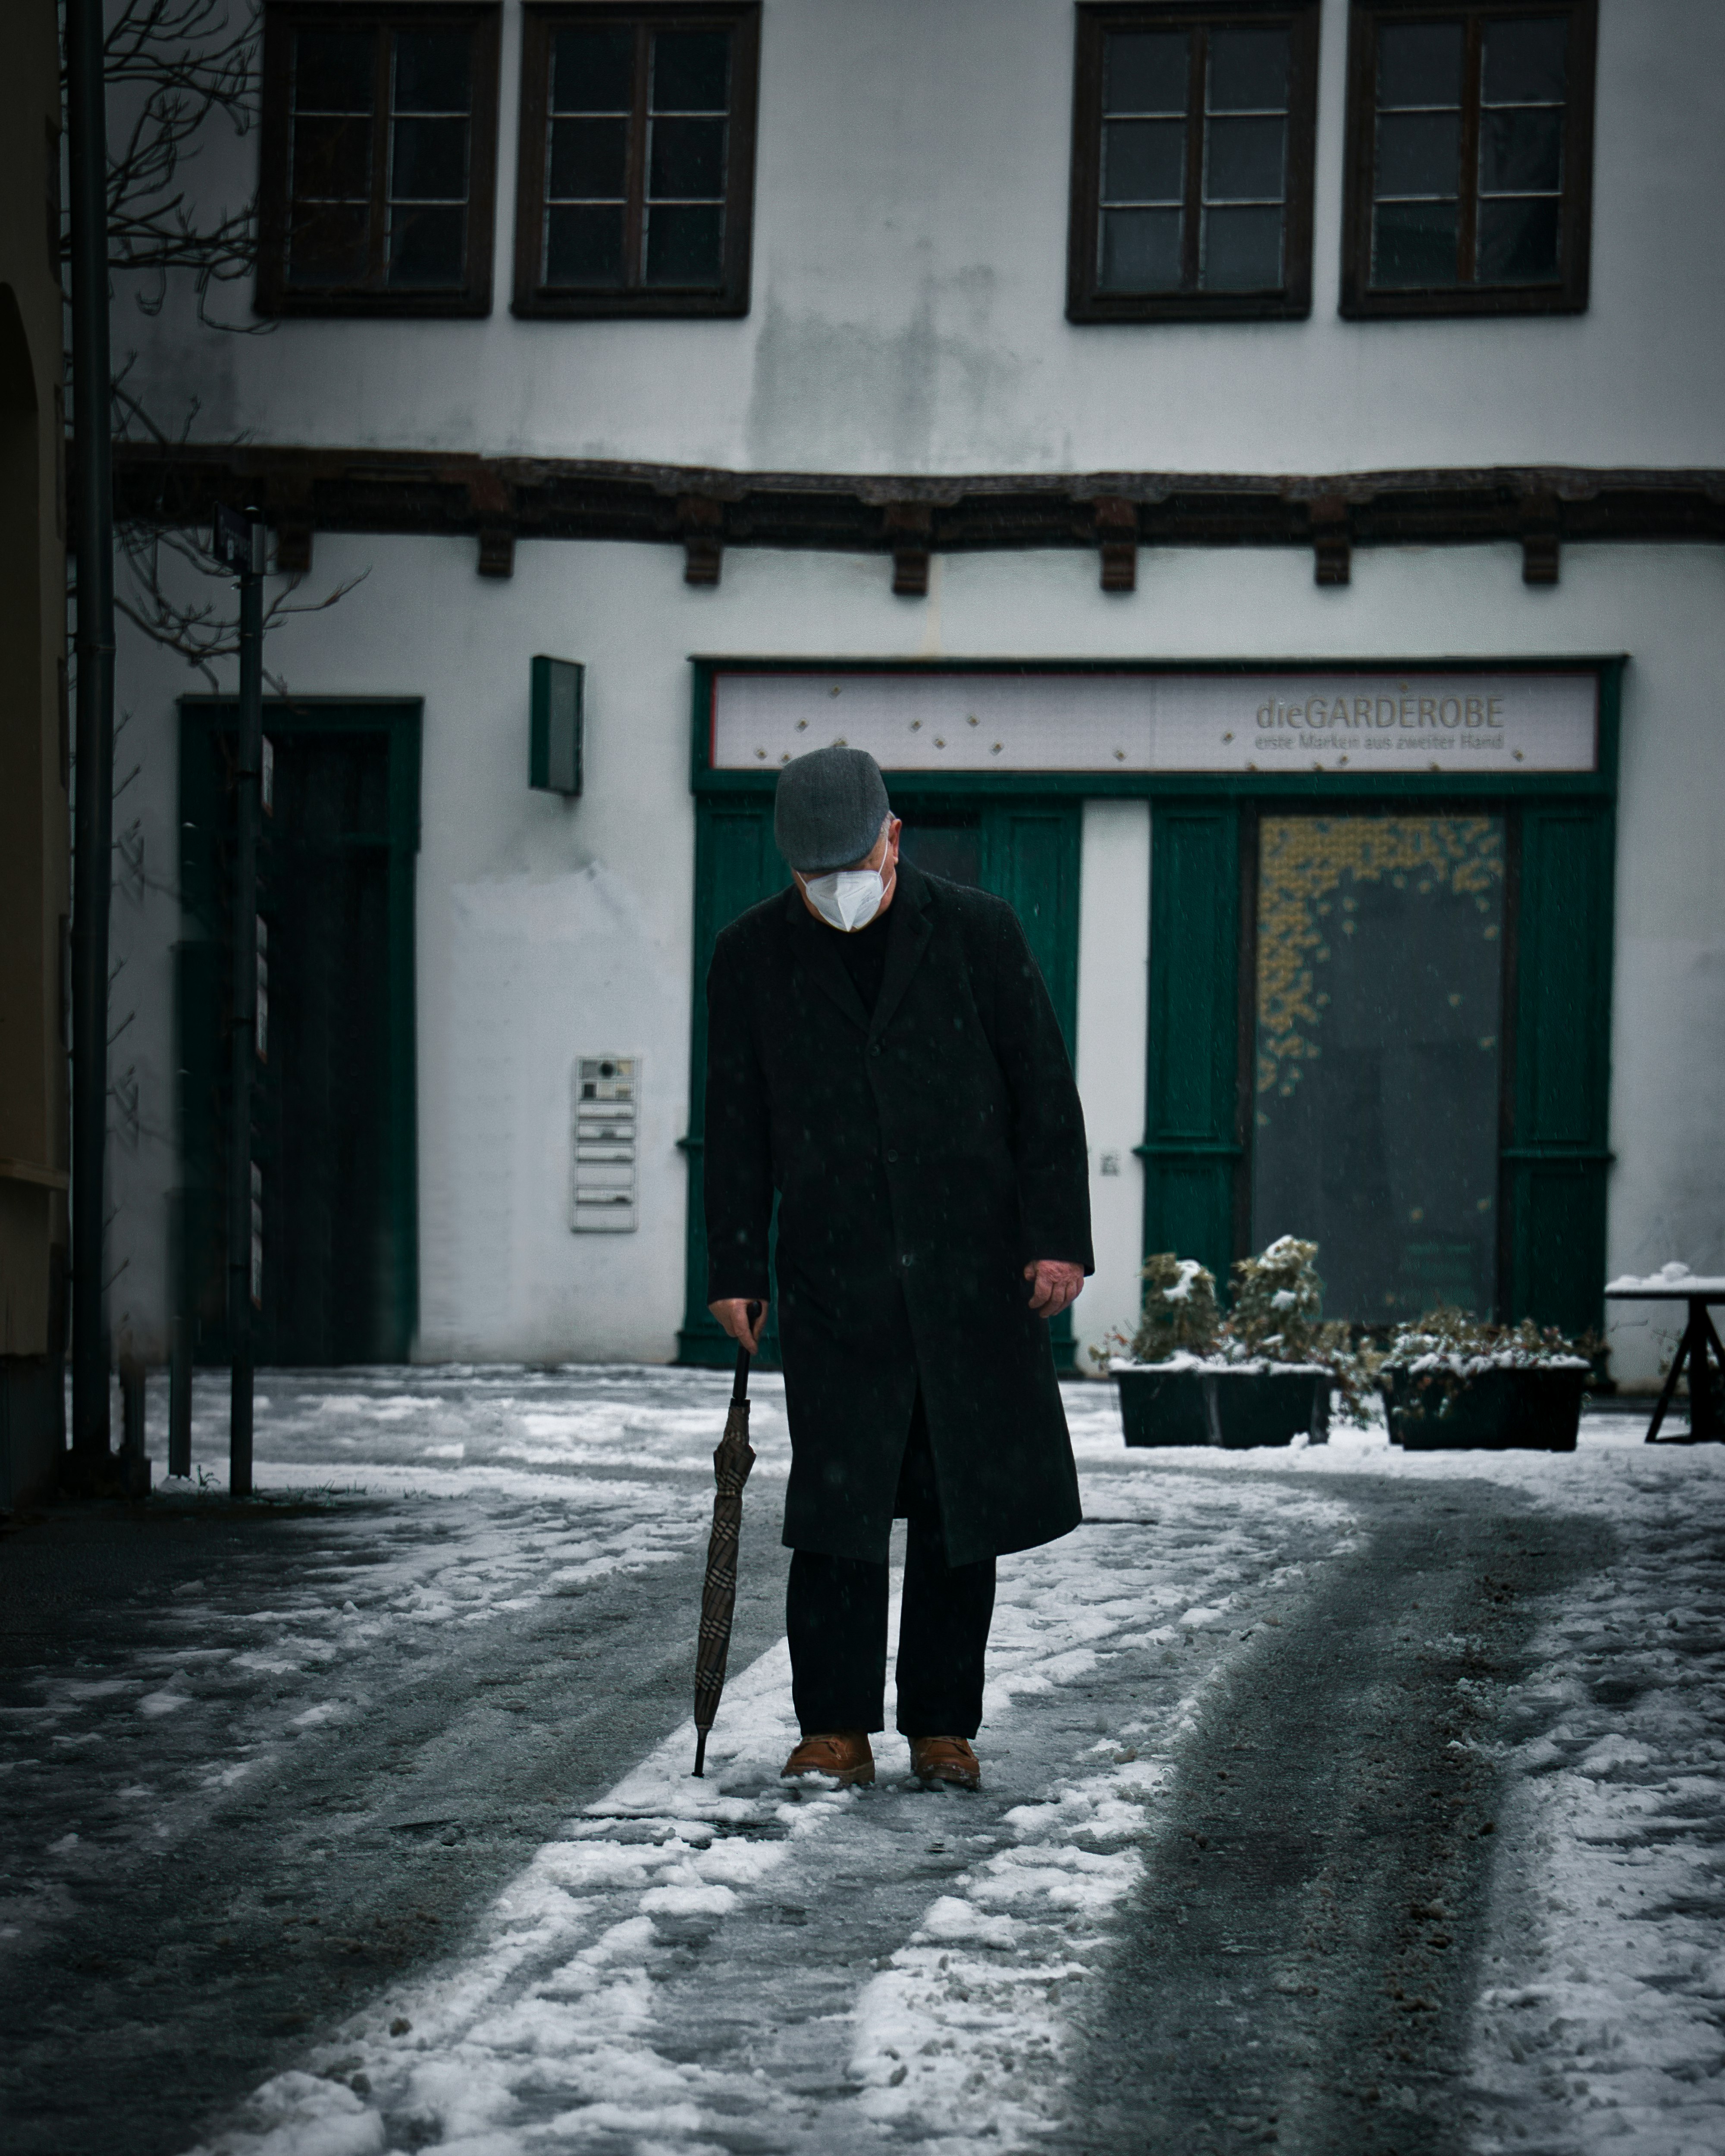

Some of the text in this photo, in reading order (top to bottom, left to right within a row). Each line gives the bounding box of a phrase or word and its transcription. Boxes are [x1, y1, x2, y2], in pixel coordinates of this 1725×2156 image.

[1256, 697, 1505, 729] dieGARDEROBE
[1255, 733, 1505, 750] erste Marken aus zweiter Hand
